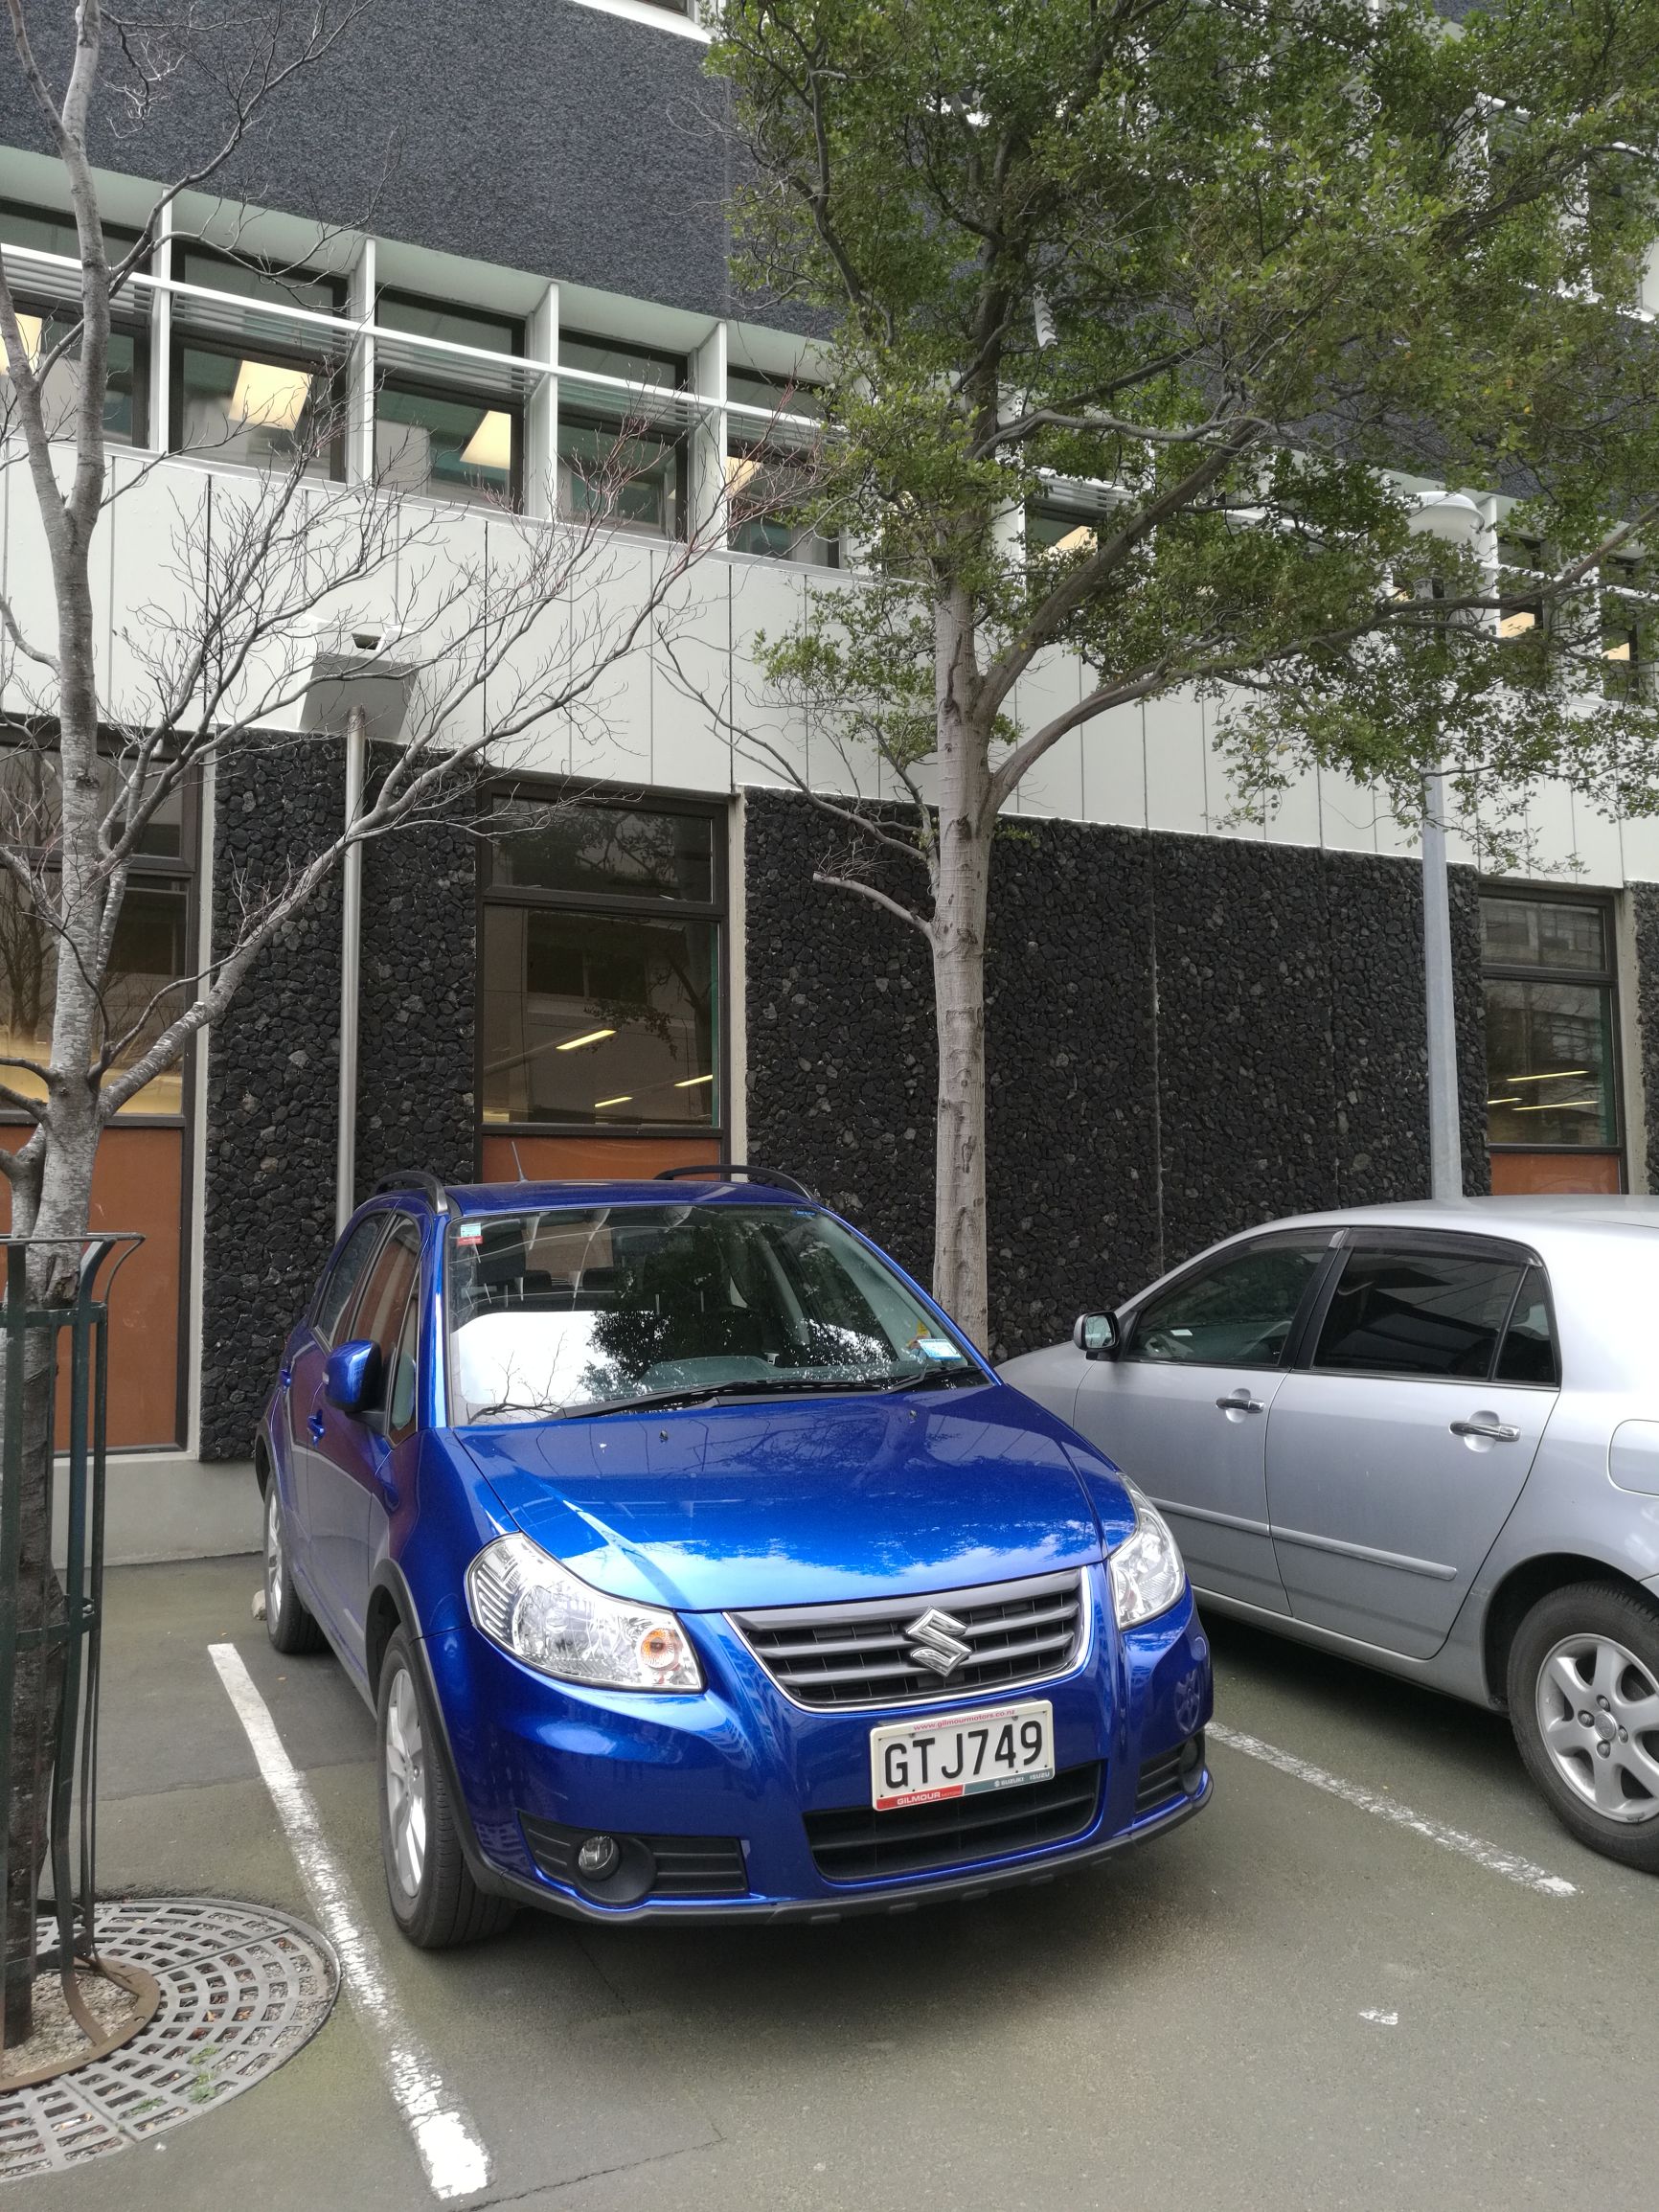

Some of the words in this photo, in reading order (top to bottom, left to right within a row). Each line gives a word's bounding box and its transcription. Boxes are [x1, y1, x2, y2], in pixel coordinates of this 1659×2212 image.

[884, 1720, 1042, 1789] GTJ749
[1001, 1776, 1025, 1786] SUZUKI
[1029, 1771, 1050, 1780] ISUZU
[897, 1791, 941, 1805] GILMOUR
